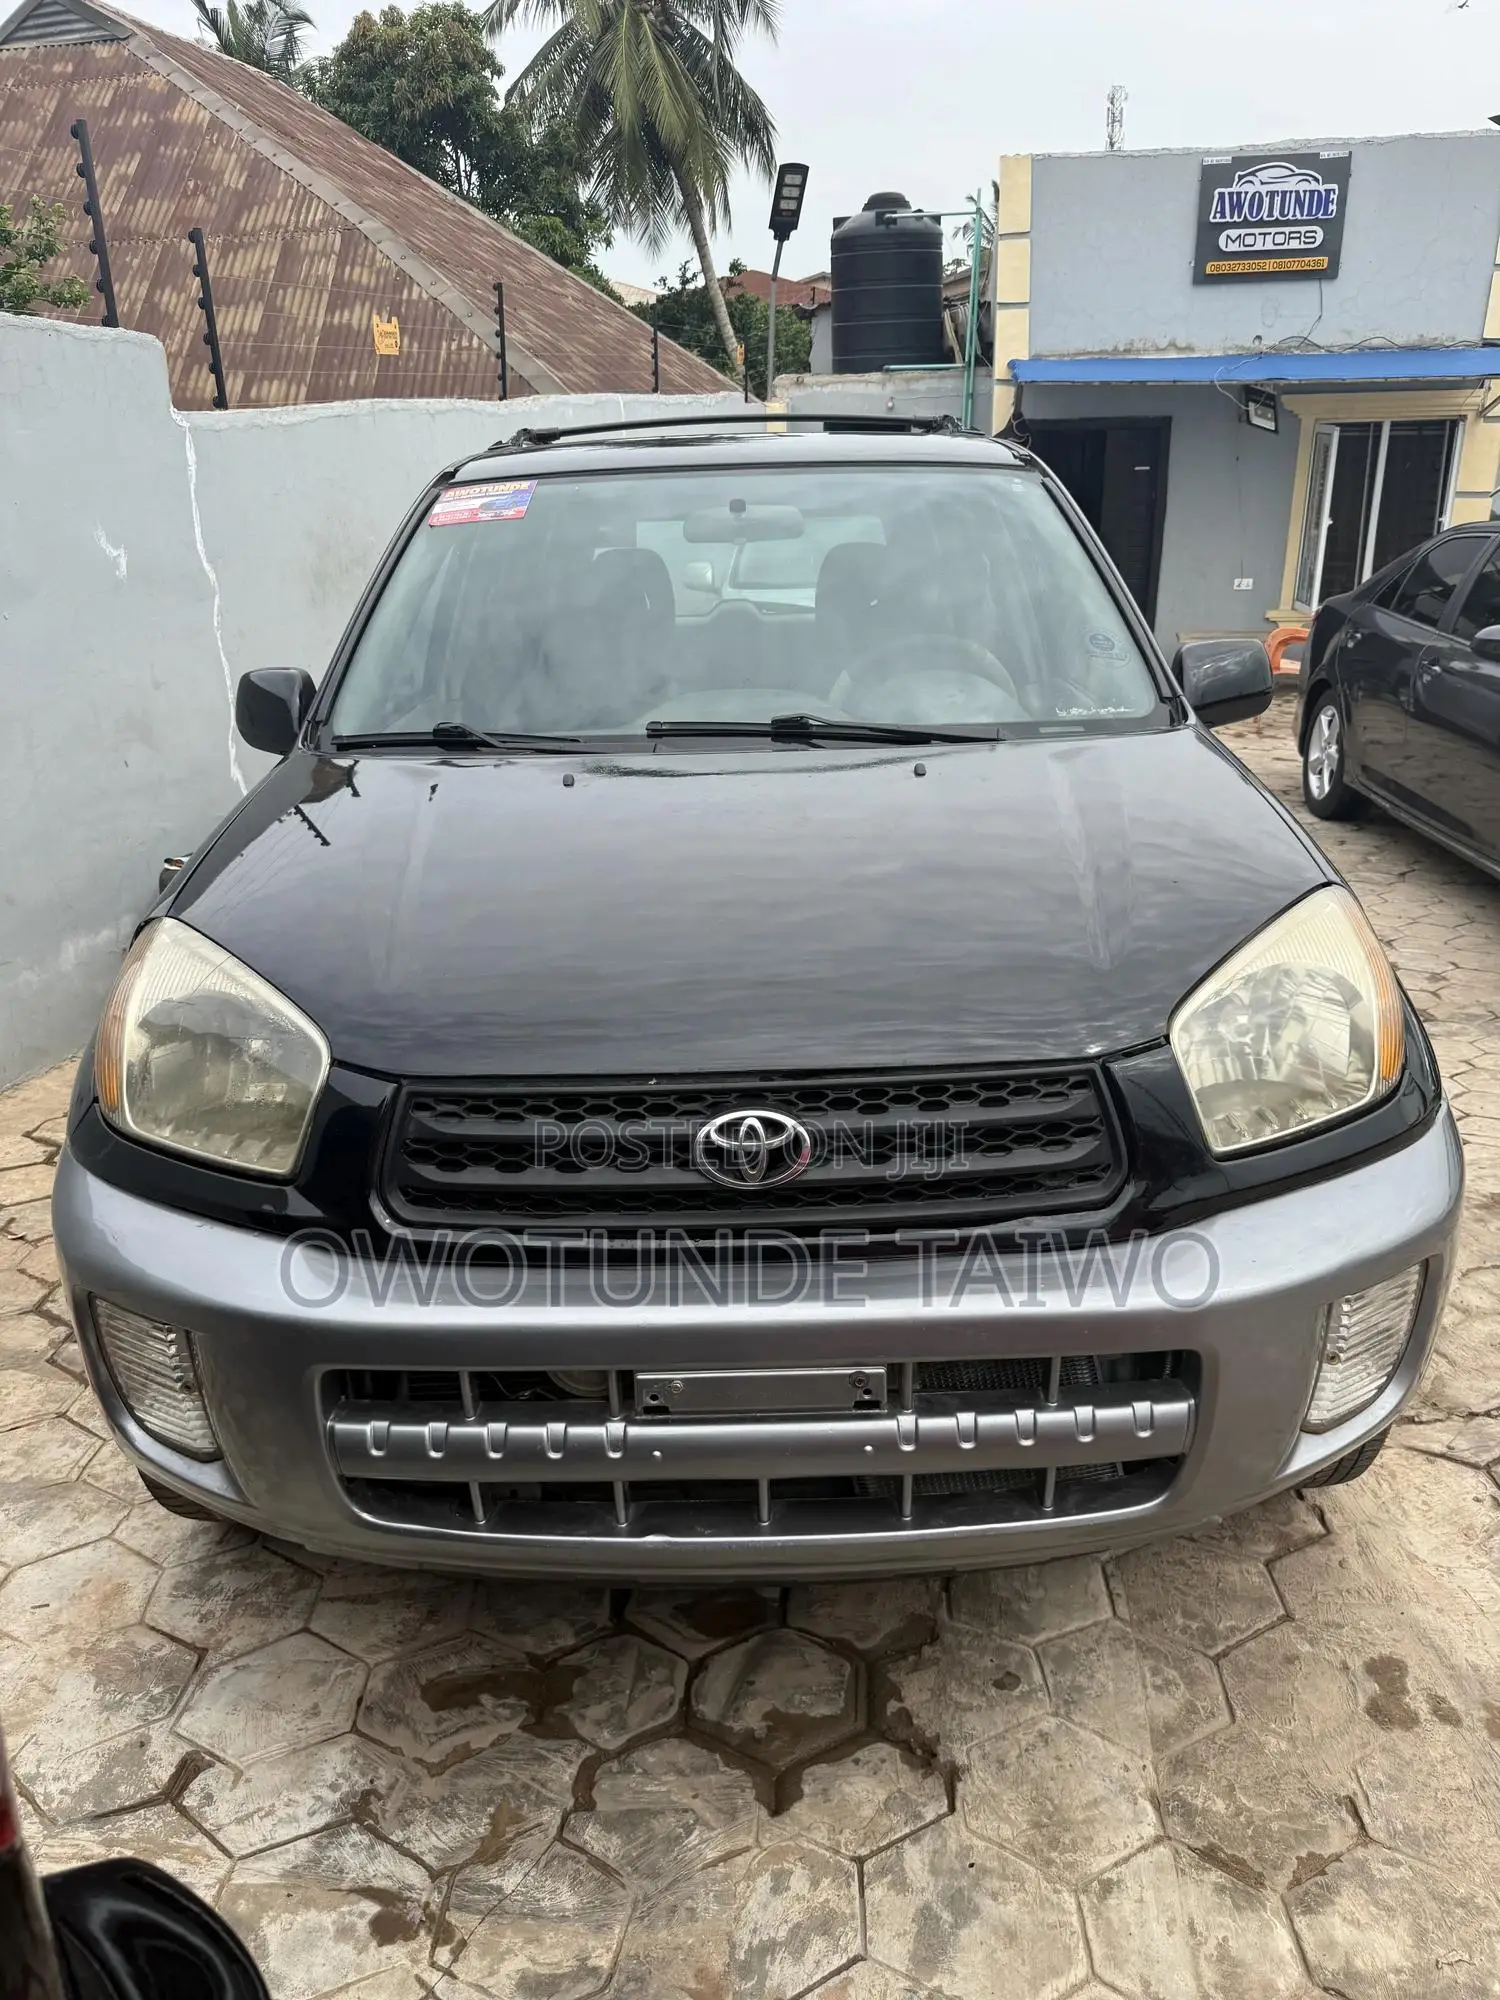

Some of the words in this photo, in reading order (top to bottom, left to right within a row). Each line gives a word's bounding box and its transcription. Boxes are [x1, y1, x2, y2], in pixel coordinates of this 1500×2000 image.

[1212, 188, 1336, 220] AWOTUNDE
[1225, 230, 1318, 248] MOTORS
[1209, 261, 1267, 273] 08032733052
[1272, 258, 1326, 270] 08107704361
